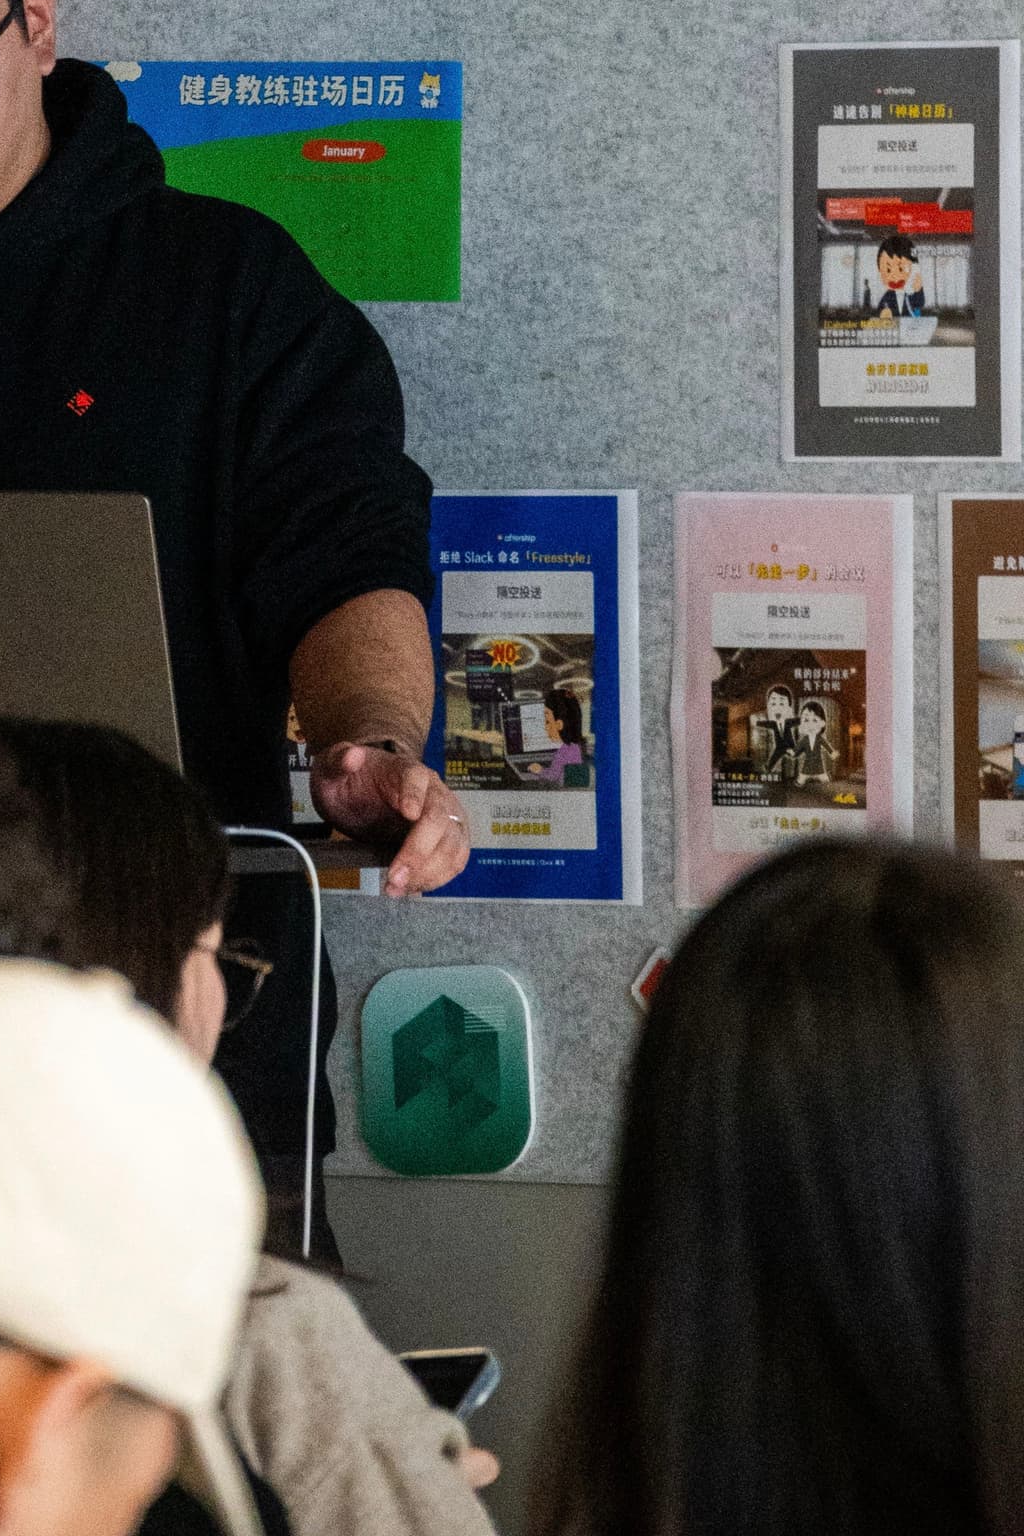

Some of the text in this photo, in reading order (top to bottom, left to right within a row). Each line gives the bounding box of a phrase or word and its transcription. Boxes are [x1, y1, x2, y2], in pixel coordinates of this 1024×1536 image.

[179, 73, 405, 106] 健身教练驻场日历
[322, 144, 366, 159] January
[439, 551, 461, 564] 拒绝
[464, 551, 494, 564] Slack
[498, 550, 520, 564] 命名
[497, 586, 542, 599] 隔空投送
[492, 643, 517, 661] NO
